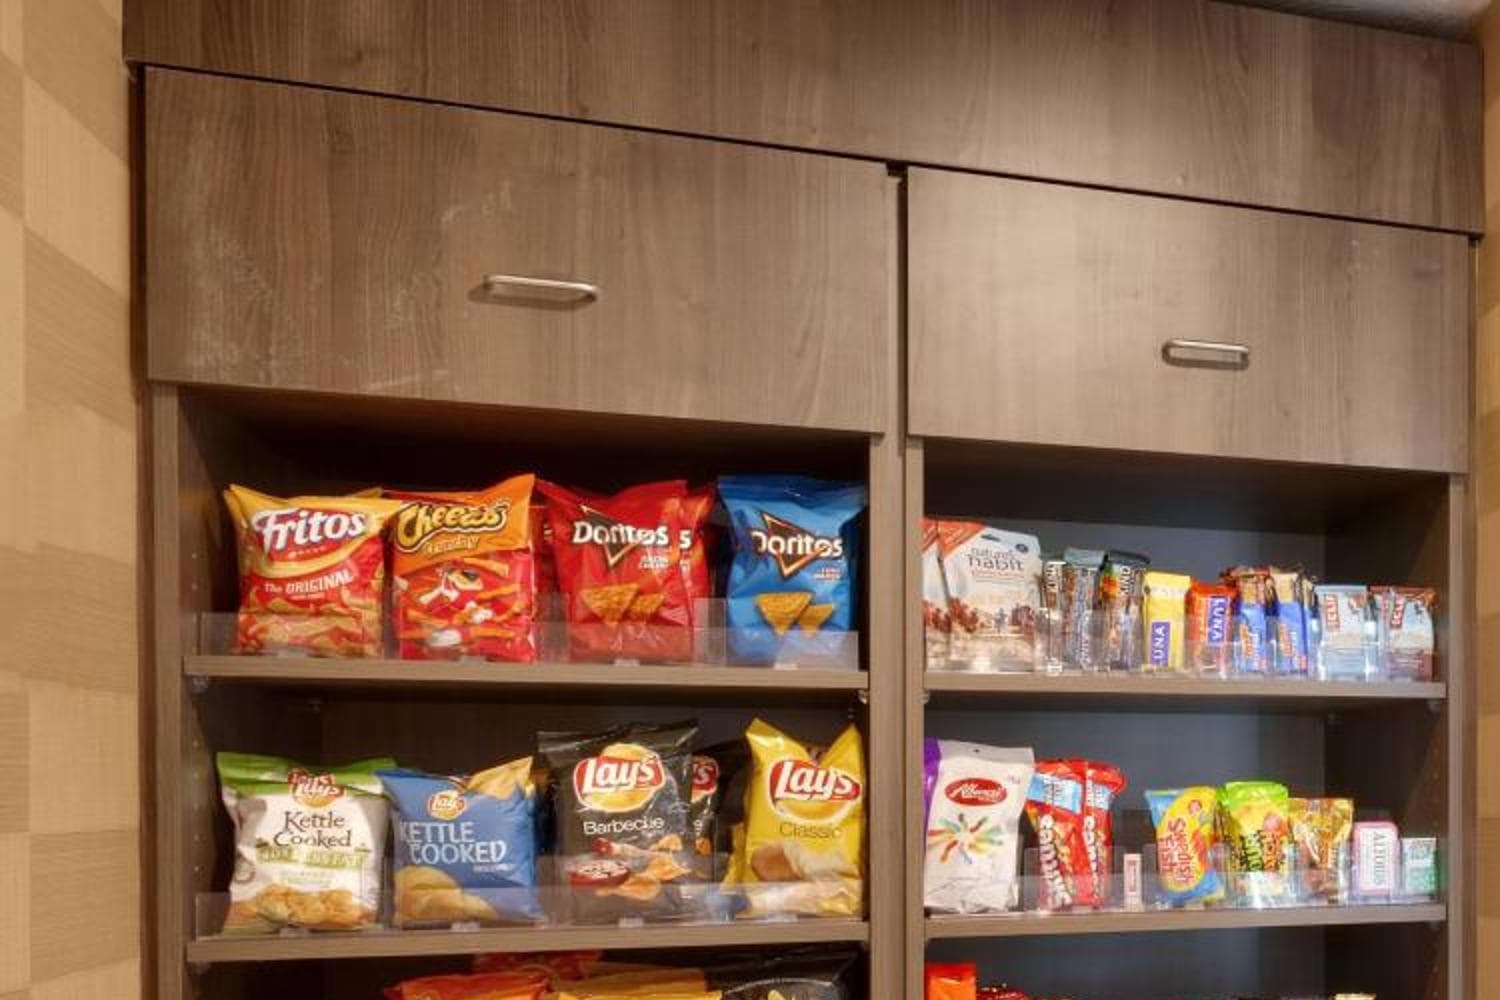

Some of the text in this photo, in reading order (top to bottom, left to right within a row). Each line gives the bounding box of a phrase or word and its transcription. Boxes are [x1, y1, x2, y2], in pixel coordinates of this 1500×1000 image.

[251, 507, 368, 551] Fritos
[572, 521, 670, 547] Doritos
[750, 529, 843, 558] Doritos
[285, 567, 354, 595] ORIGINAL
[1214, 597, 1226, 640] LUNA
[284, 810, 346, 833] Kettle
[583, 816, 664, 835] Barbecue
[779, 822, 842, 841] Classic
[273, 830, 353, 849] Cooked
[409, 841, 507, 865] COOKED
